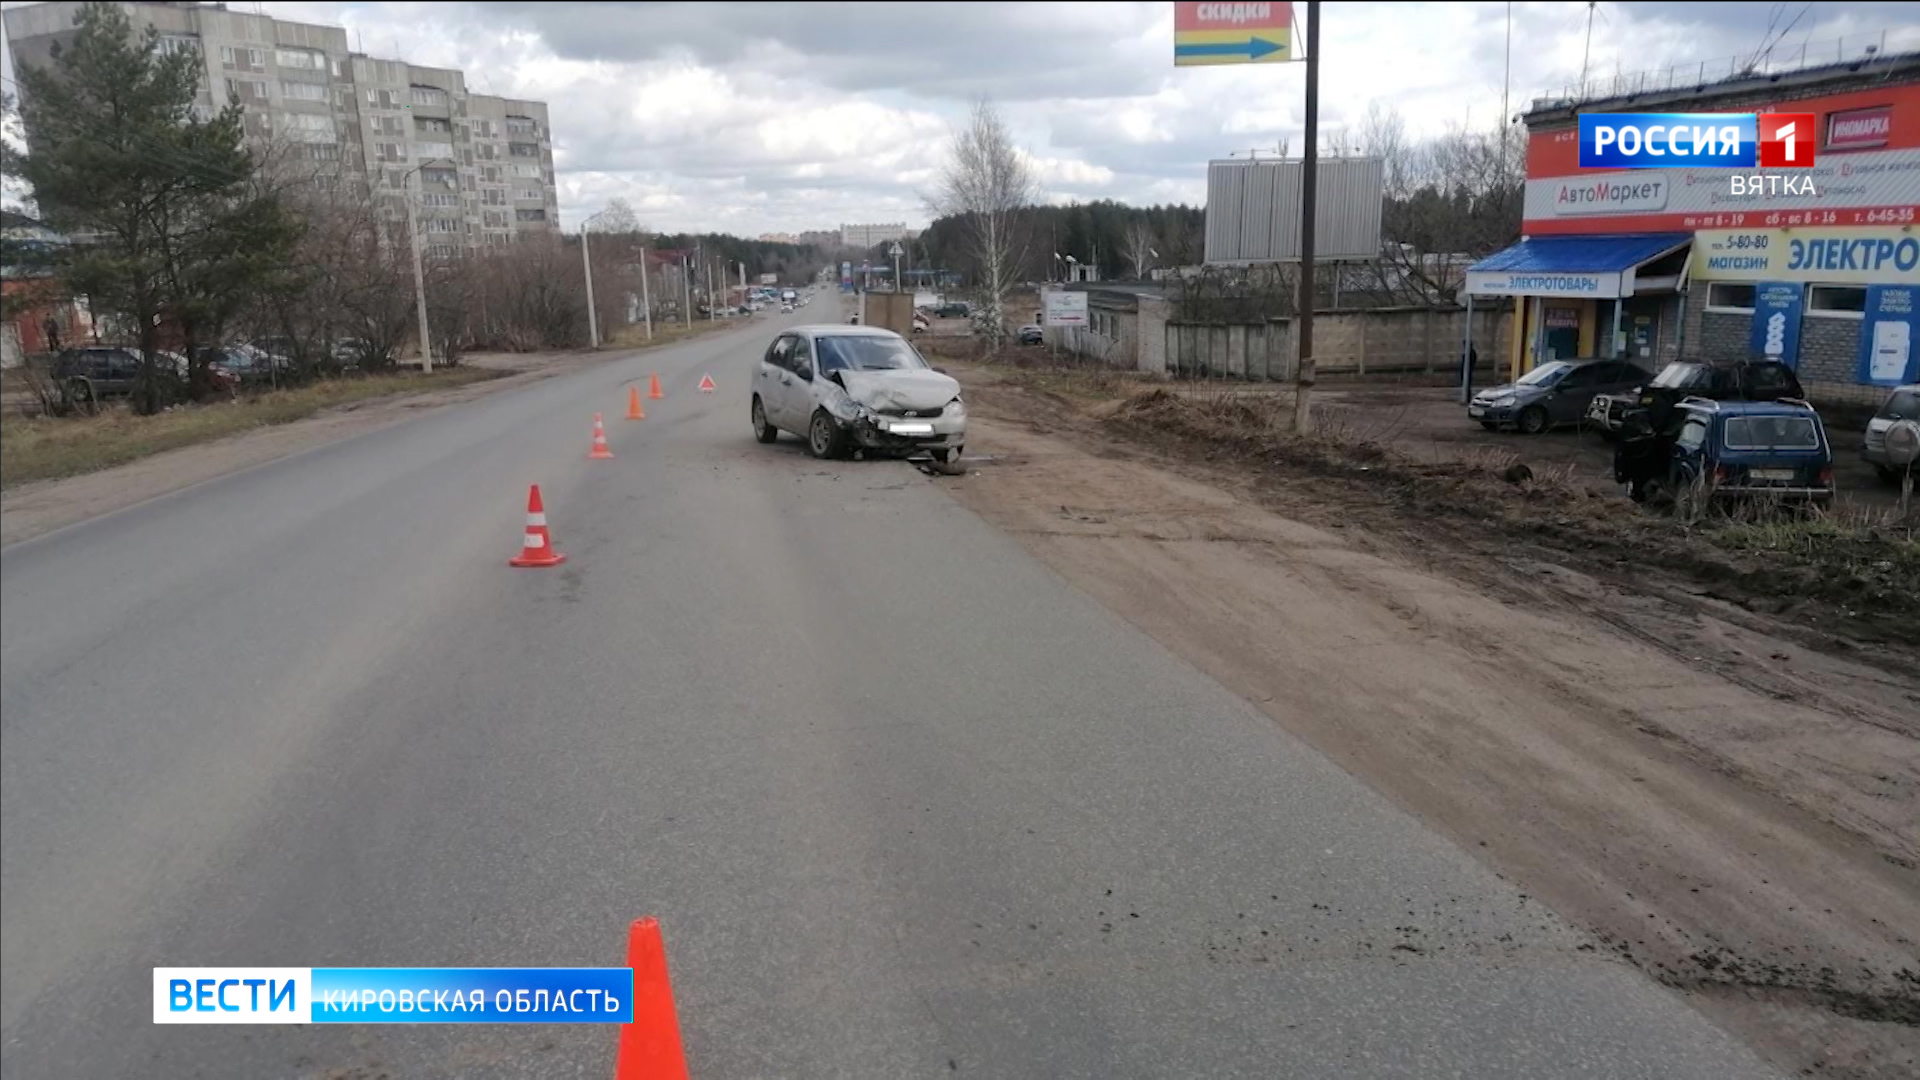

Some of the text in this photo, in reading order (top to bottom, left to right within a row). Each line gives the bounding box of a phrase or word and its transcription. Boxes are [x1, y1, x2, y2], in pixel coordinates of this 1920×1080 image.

[1197, 3, 1270, 23] СКИДКИ
[1834, 117, 1889, 138] ИНОМАРКА
[1558, 182, 1662, 204] АвтоМаркет
[1731, 214, 1744, 226] 19
[1822, 211, 1836, 223] 16
[1726, 235, 1769, 250] 5-80-80
[1707, 255, 1769, 270] магазин
[1787, 237, 1920, 272] ЭЛЕКТРО
[1508, 275, 1599, 291] ЭЛЕКТРОТОВАРЫ
